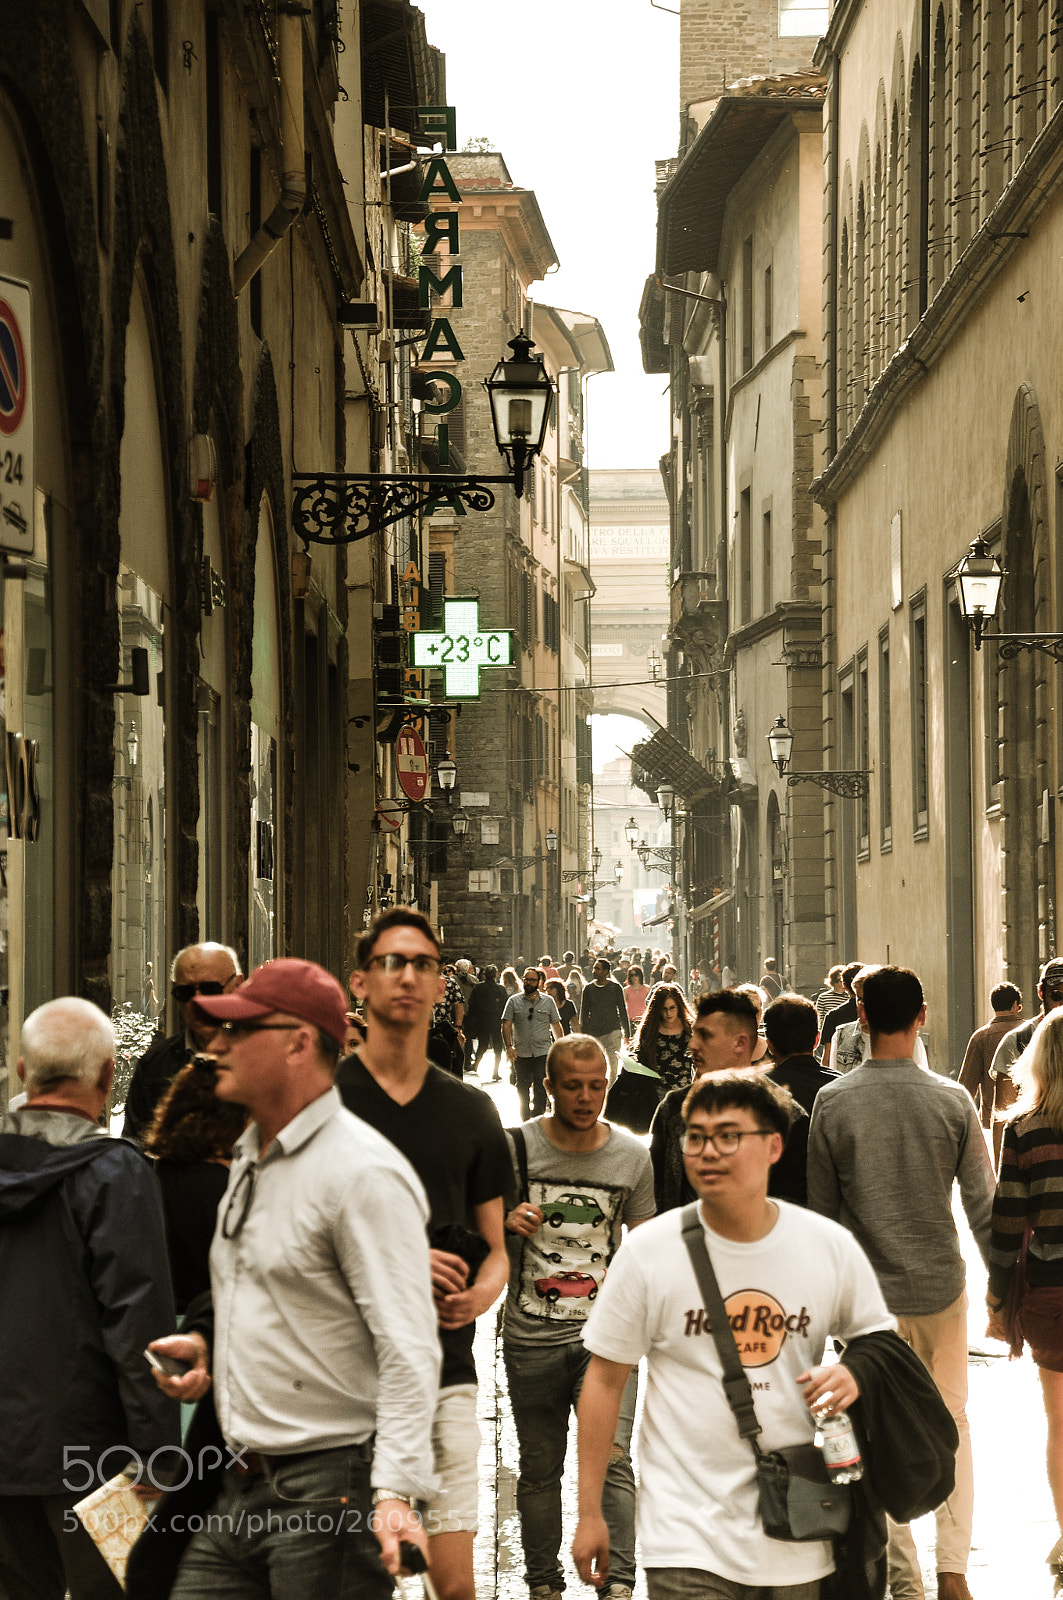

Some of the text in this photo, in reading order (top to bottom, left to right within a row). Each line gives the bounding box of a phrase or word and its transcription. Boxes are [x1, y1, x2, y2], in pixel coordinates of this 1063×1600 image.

[620, 528, 655, 536] DELLA
[754, 1306, 810, 1338] Rock
[751, 1382, 770, 1391] ME
